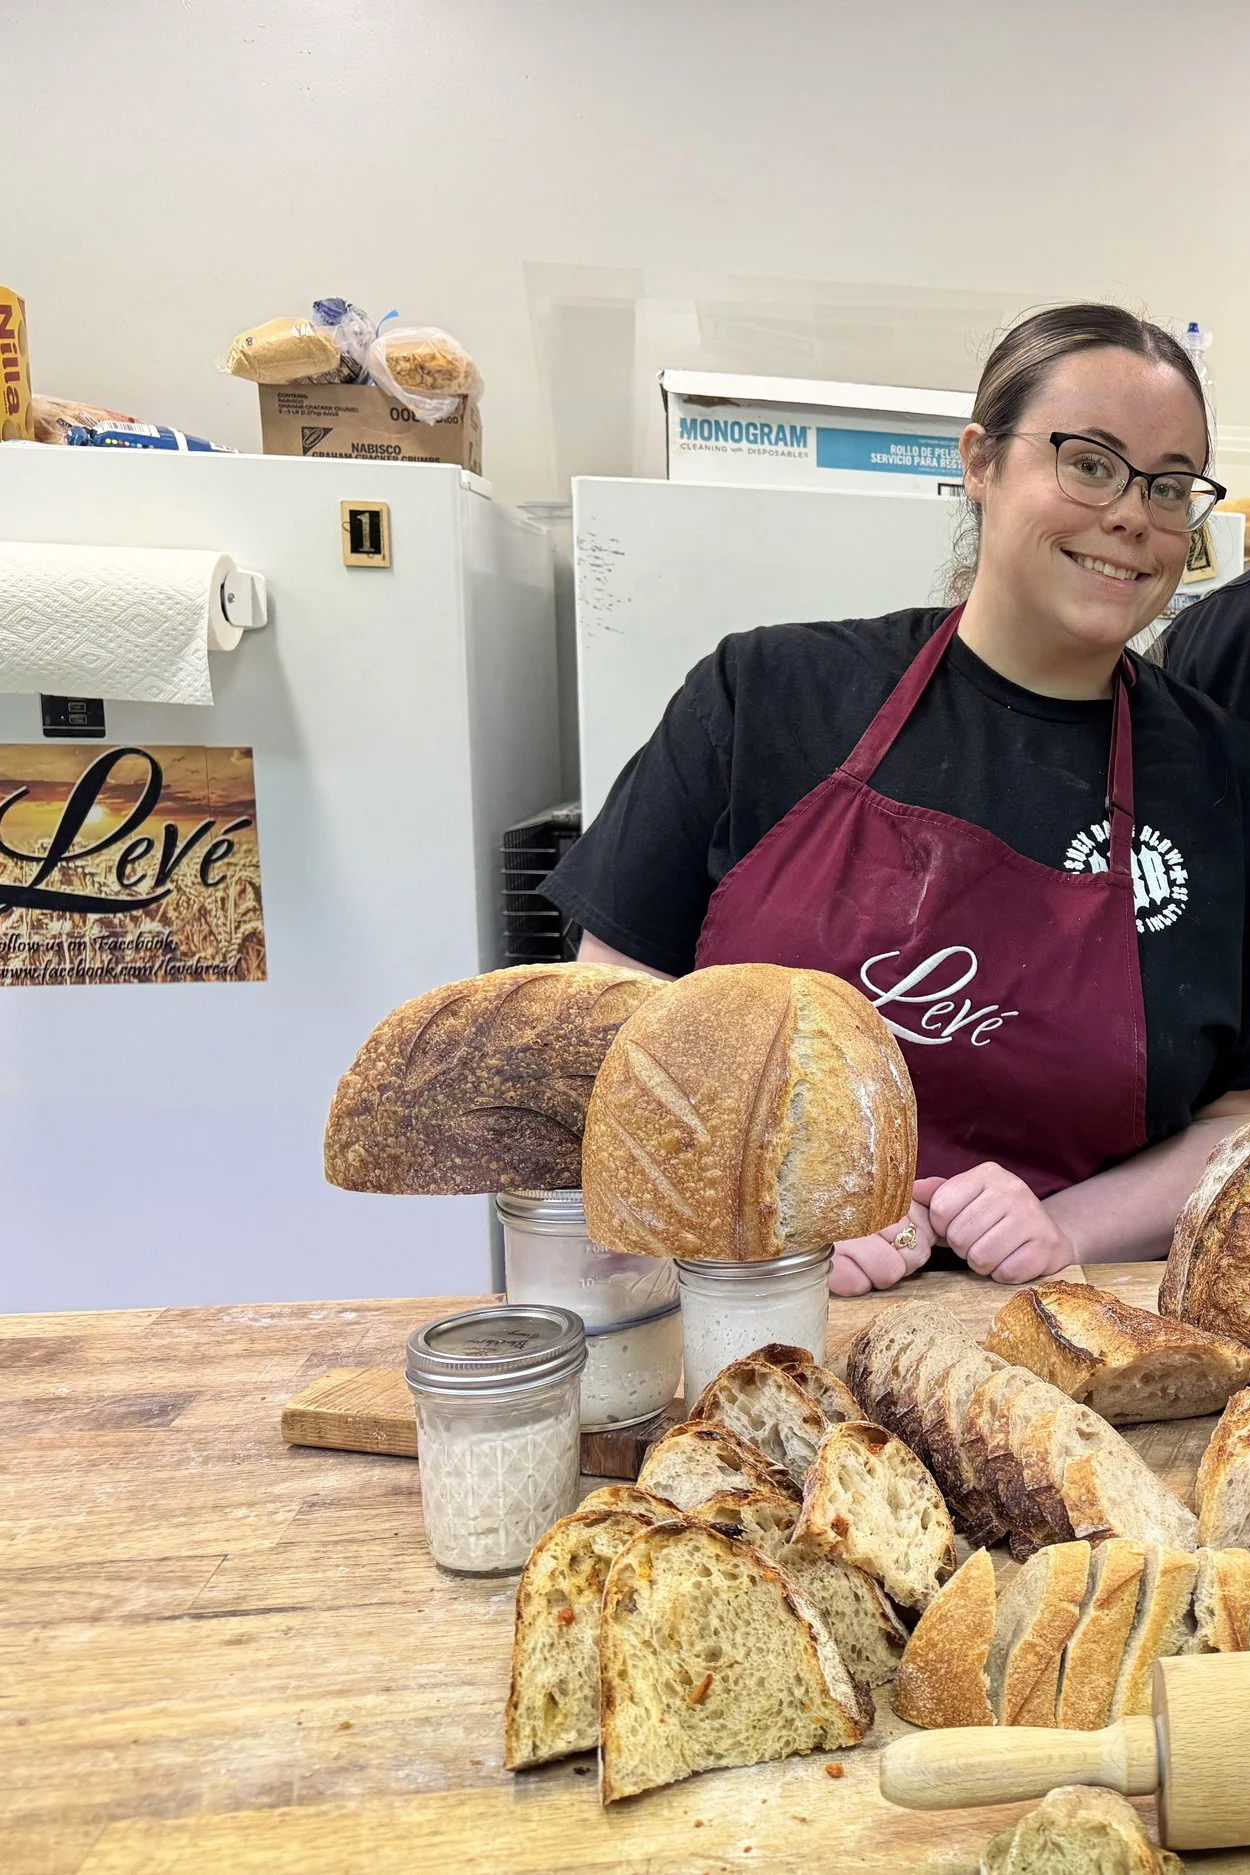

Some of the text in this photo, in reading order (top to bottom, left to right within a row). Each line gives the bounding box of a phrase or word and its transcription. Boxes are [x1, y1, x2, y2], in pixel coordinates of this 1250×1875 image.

[0, 304, 21, 416] Nilla
[351, 442, 402, 456] NABISCO
[679, 417, 808, 449] MONOGRAM
[680, 443, 728, 453] CLEANING
[747, 447, 809, 459] DISPOSABLES
[870, 453, 912, 466] SERVICIO
[914, 456, 938, 468] PARA
[890, 444, 919, 456] ROLLO
[921, 447, 933, 458] DE
[356, 512, 375, 552] 1
[0, 747, 253, 914] Levé
[1140, 825, 1184, 865] BLOW
[45, 938, 63, 952] us
[67, 938, 88, 952] on
[860, 945, 1019, 1046] Levé
